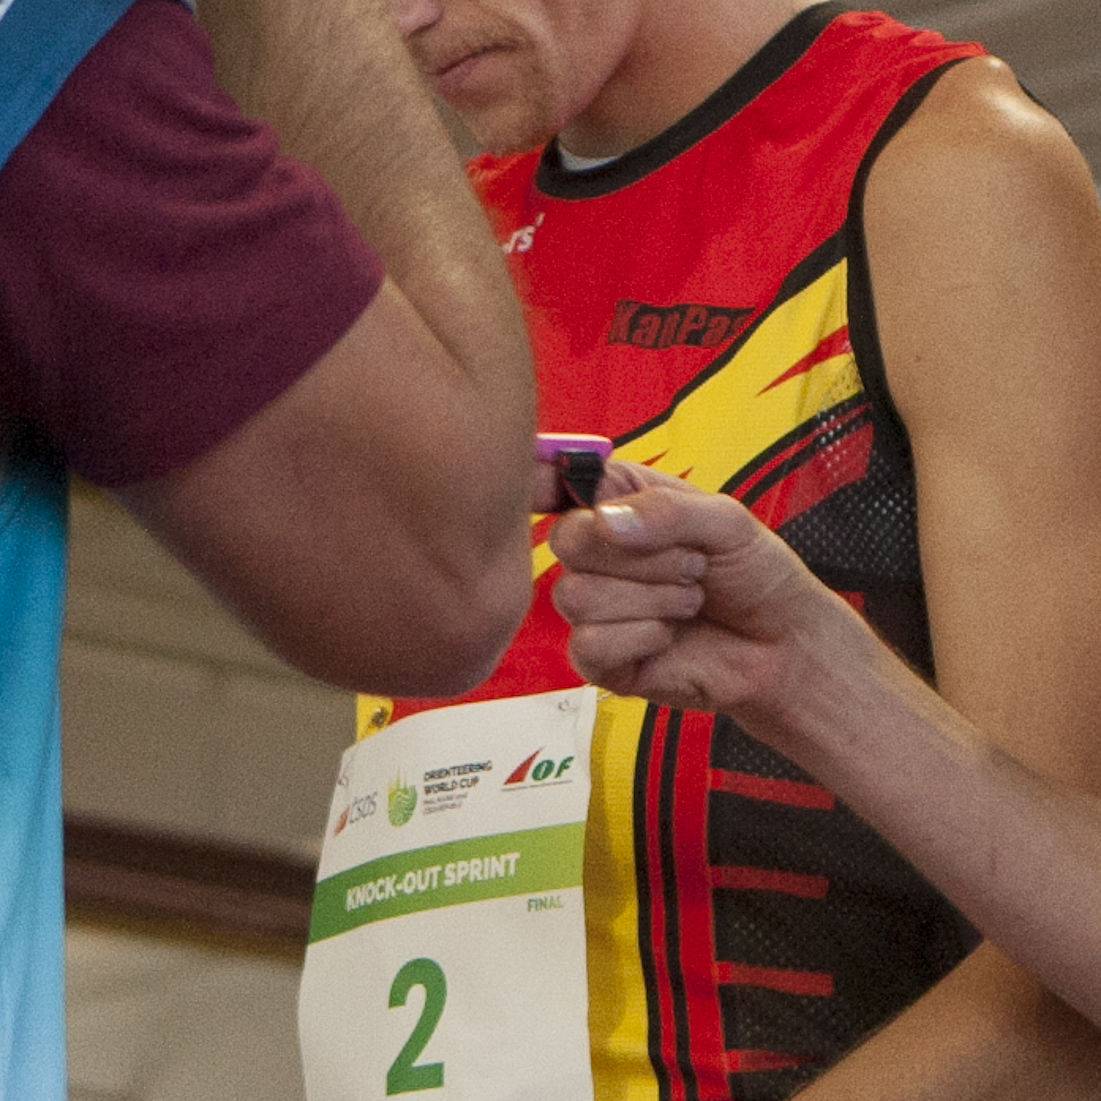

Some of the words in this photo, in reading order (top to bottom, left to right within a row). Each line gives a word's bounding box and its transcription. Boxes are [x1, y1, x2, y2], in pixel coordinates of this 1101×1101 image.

[424, 760, 493, 782] ORIENTEERING
[424, 780, 459, 795] WORLD
[459, 776, 479, 790] CUP
[346, 865, 441, 911] KNOCK-OUT
[444, 853, 520, 886] SPRINT
[527, 898, 565, 913] FINAL
[386, 957, 448, 1096] 2
